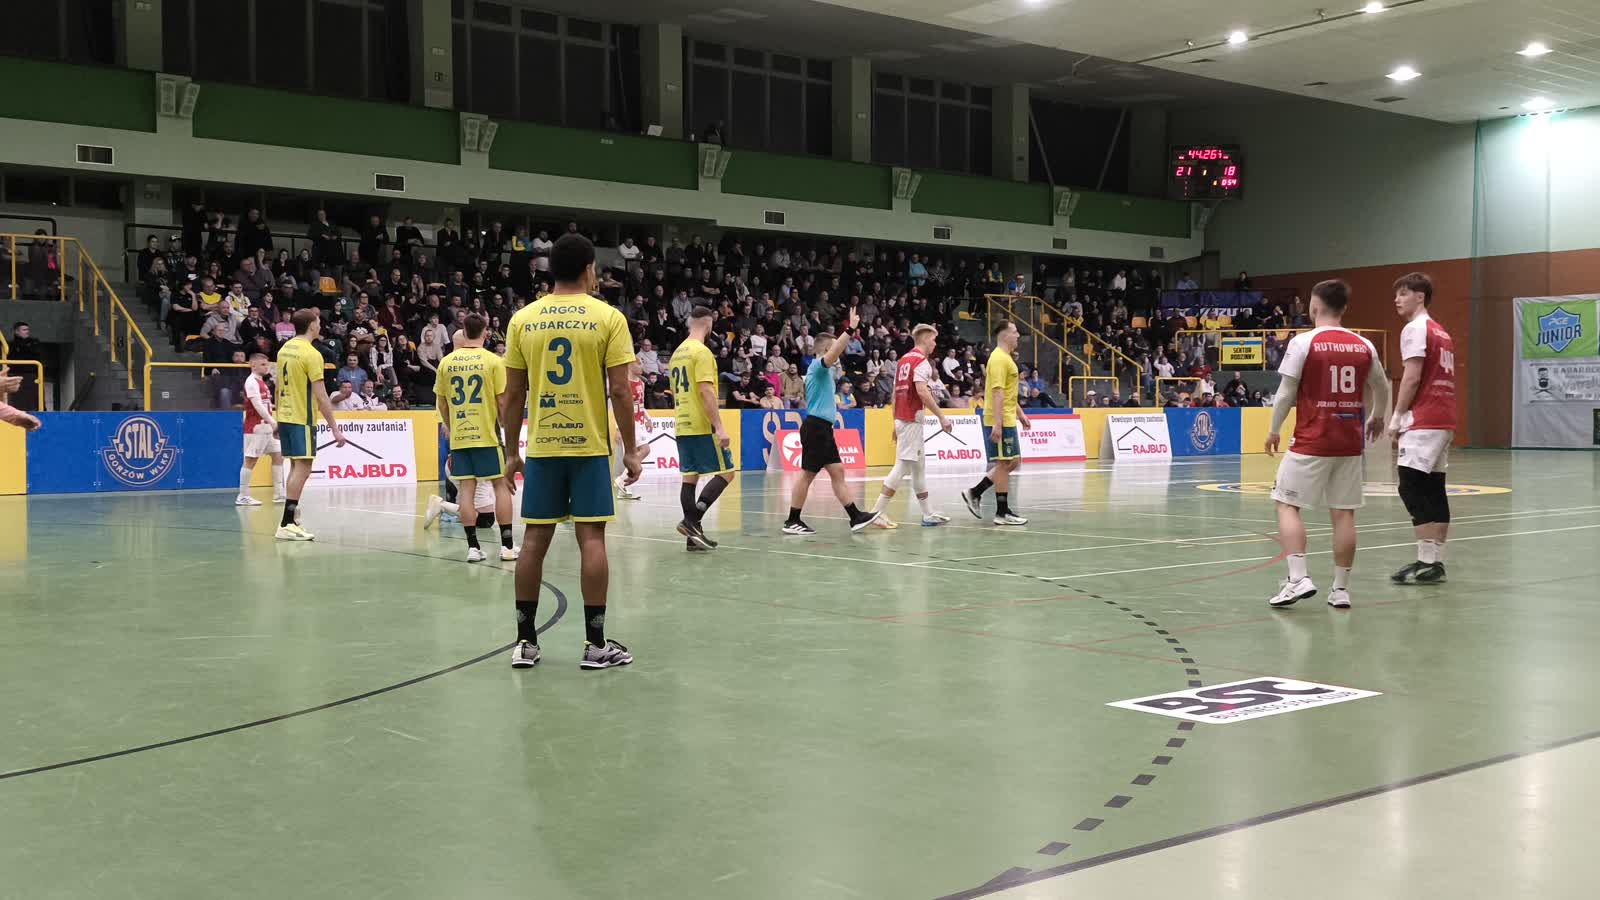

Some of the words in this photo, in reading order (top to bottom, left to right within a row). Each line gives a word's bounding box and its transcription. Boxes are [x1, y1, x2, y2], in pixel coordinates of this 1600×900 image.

[1224, 166, 1236, 176] 18
[540, 306, 586, 315] ARGOS
[525, 321, 597, 332] RYBARCZYK
[1536, 324, 1582, 346] JUNIOR
[547, 337, 573, 385] 3
[447, 364, 484, 372] RENICKI
[672, 366, 689, 393] 24
[1330, 365, 1356, 393] 18
[450, 374, 483, 405] 32
[366, 421, 407, 432] zaufania!
[125, 423, 154, 459] STAL
[938, 449, 981, 459] RAJBUD
[1133, 444, 1167, 454] RAJBUD
[328, 464, 407, 479] RAJBUD
